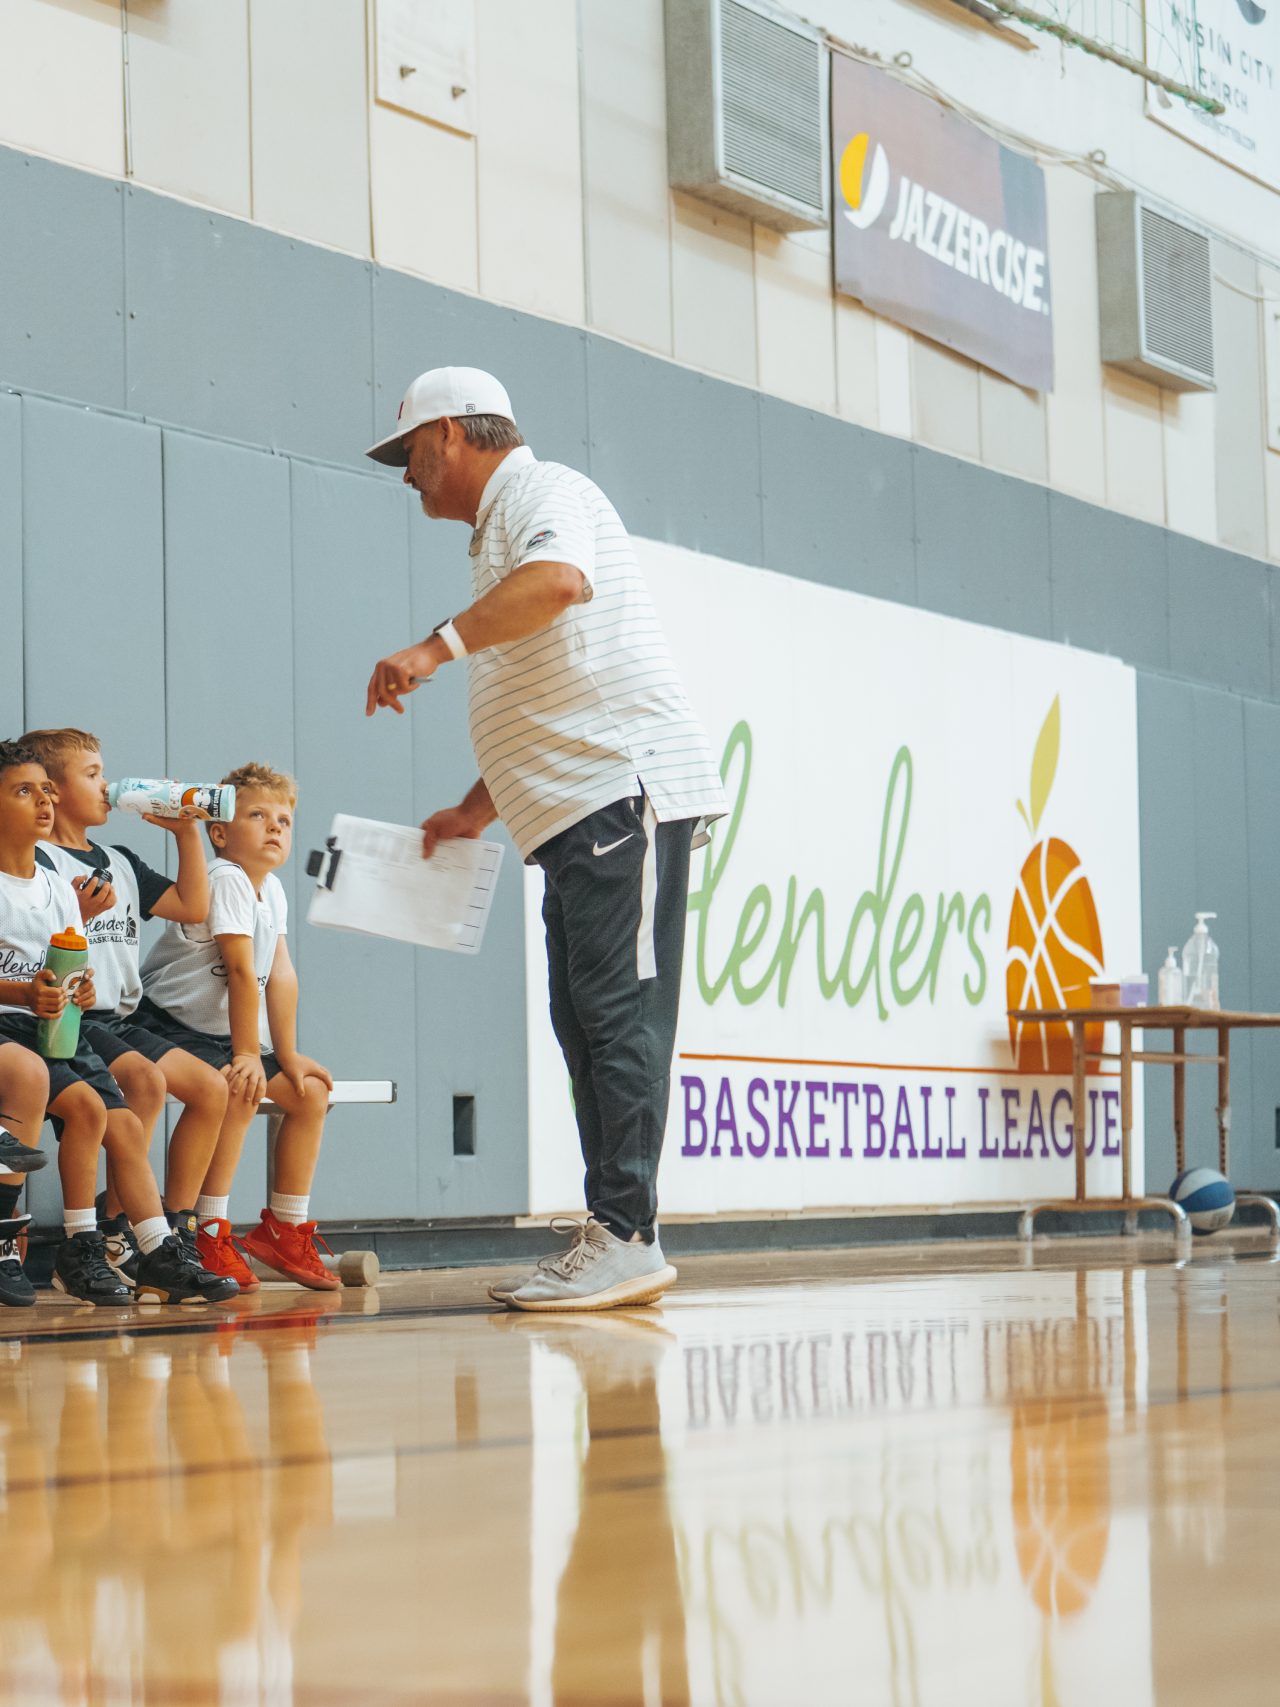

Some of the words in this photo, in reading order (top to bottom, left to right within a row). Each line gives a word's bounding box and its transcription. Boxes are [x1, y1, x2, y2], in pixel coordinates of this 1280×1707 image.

[687, 719, 992, 1022] lenders
[680, 1075, 966, 1159] BASKETBALL
[977, 1087, 1120, 1158] LEAGUE
